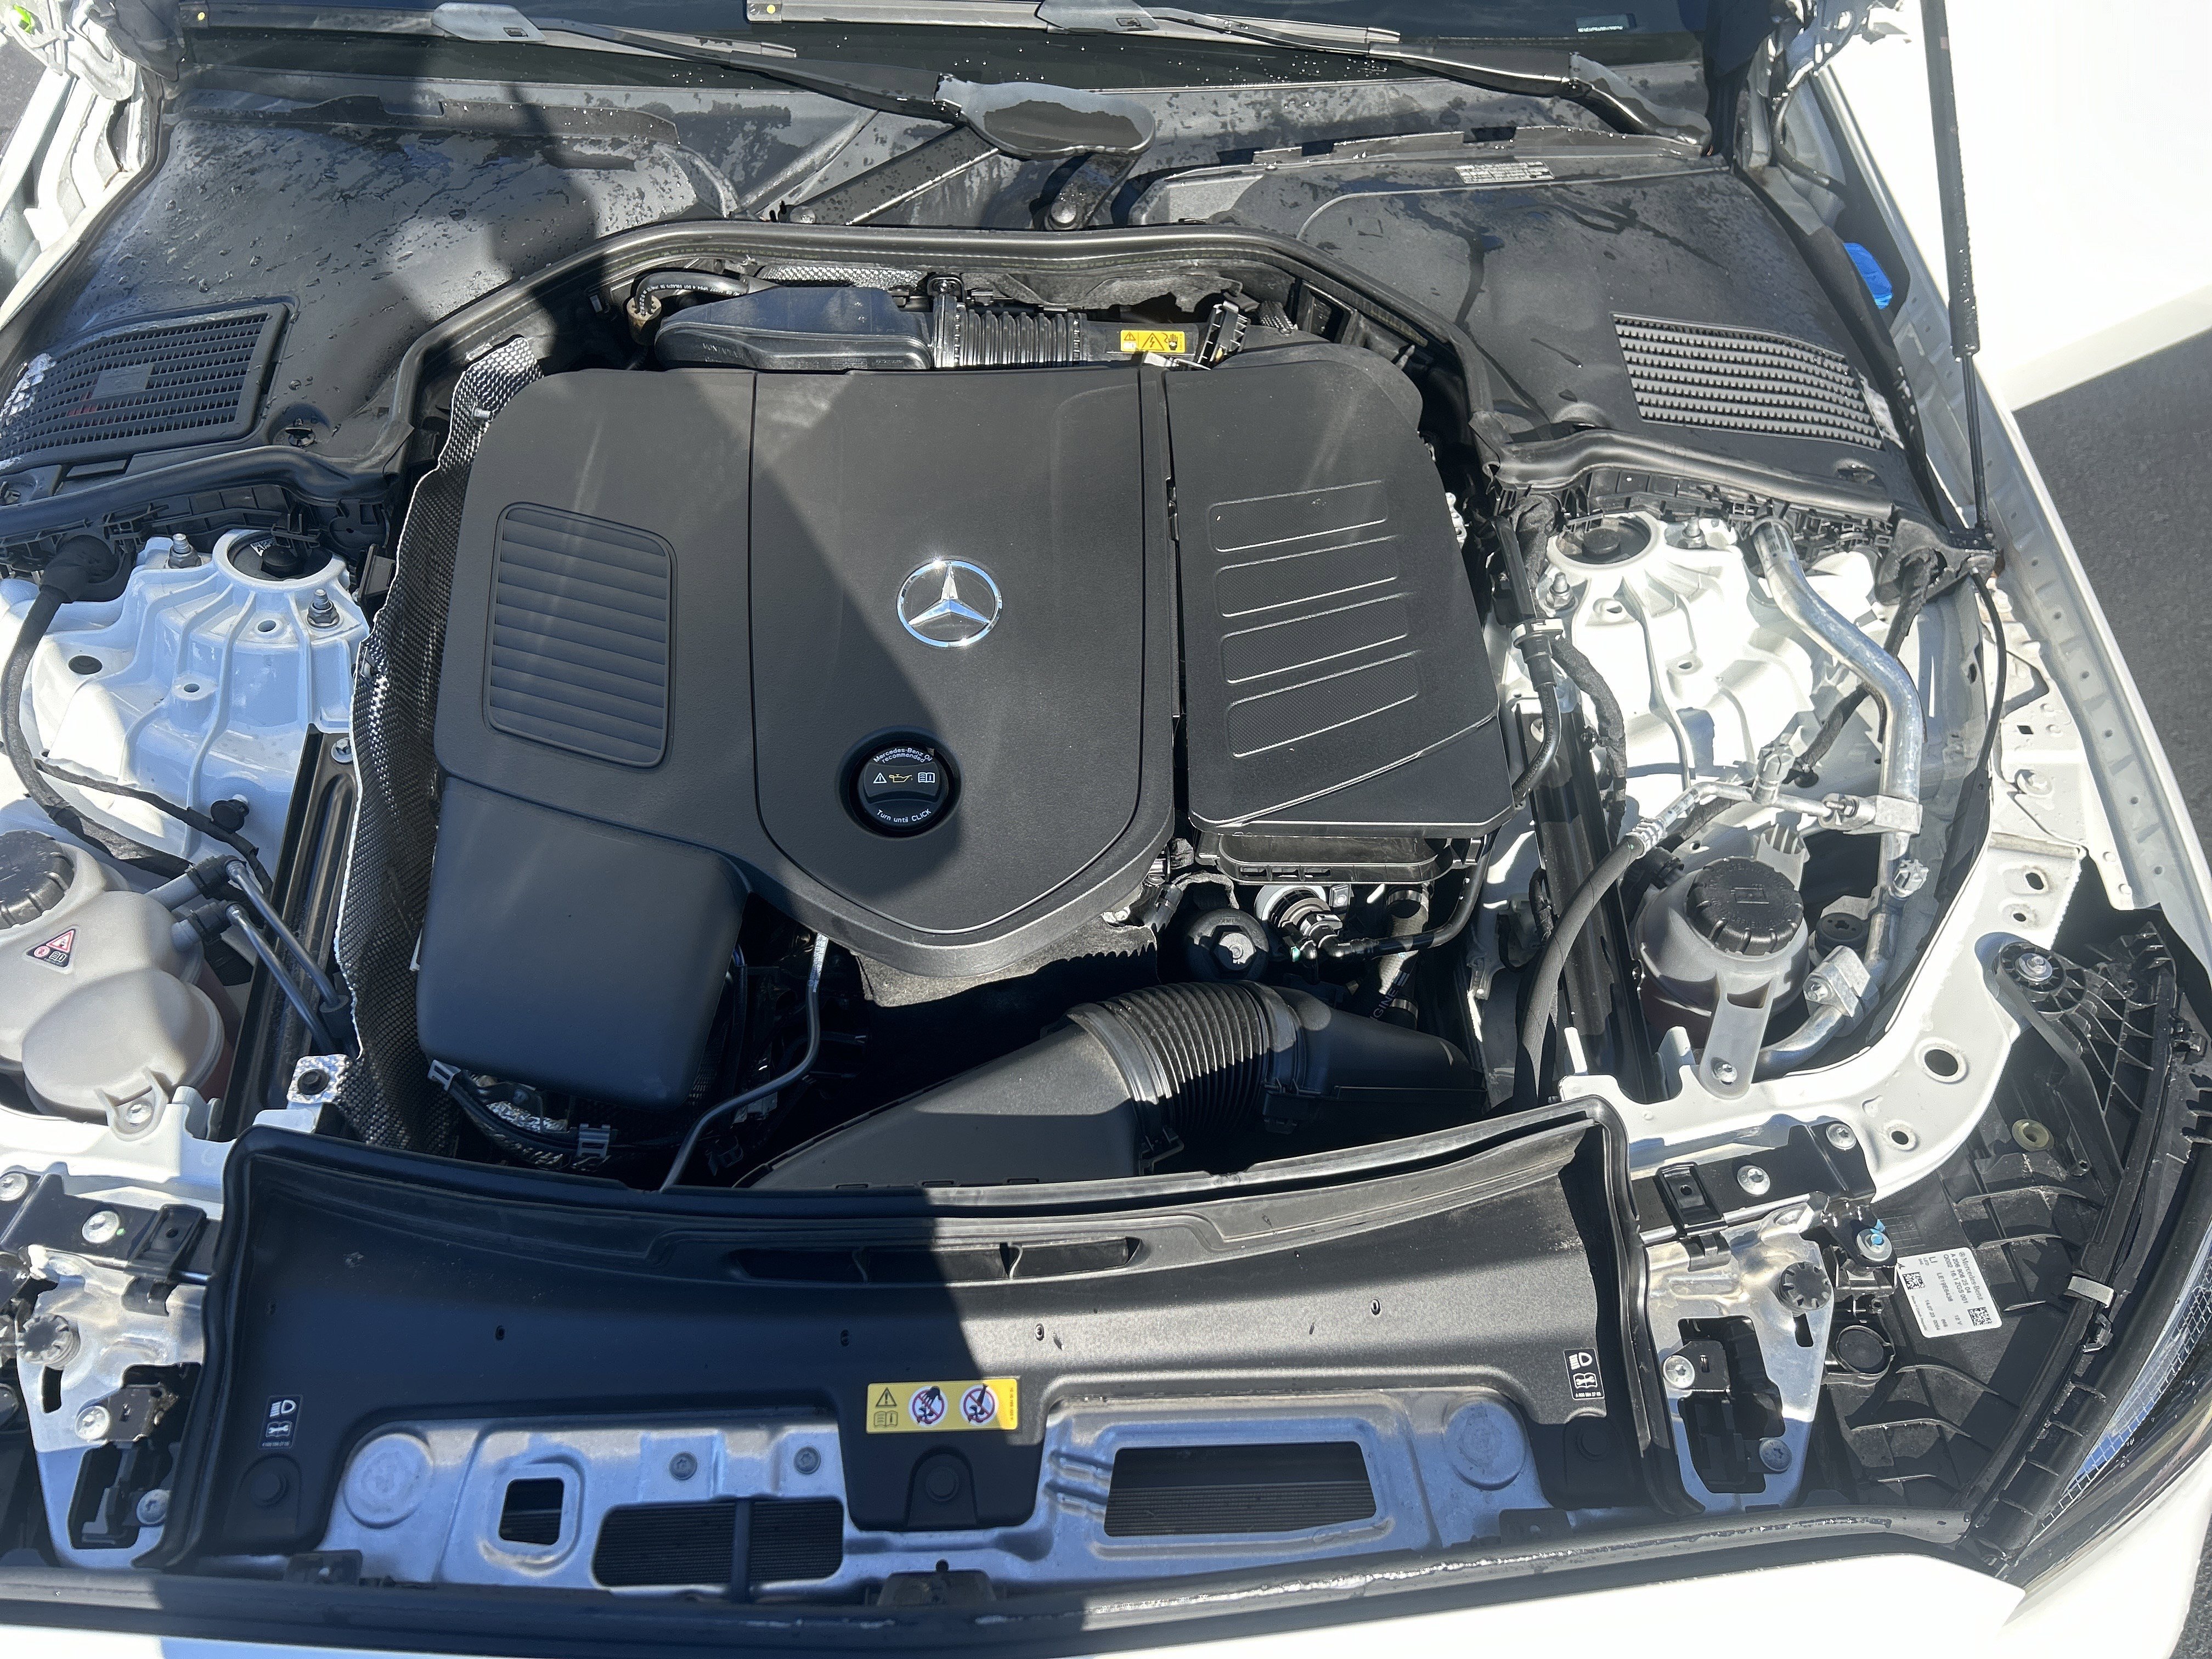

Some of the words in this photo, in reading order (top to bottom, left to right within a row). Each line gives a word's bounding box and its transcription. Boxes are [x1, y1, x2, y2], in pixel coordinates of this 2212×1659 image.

[873, 747, 924, 763] Mercedes-Benz
[882, 753, 926, 764] recommended
[876, 809, 891, 821] Turn
[911, 808, 932, 822] CLICK
[1370, 988, 1398, 1020] GINE
[1960, 1257, 1984, 1300] Mercedes-Benz
[1954, 1281, 1964, 1293] ZGS
[1959, 1294, 1968, 1303] 001
